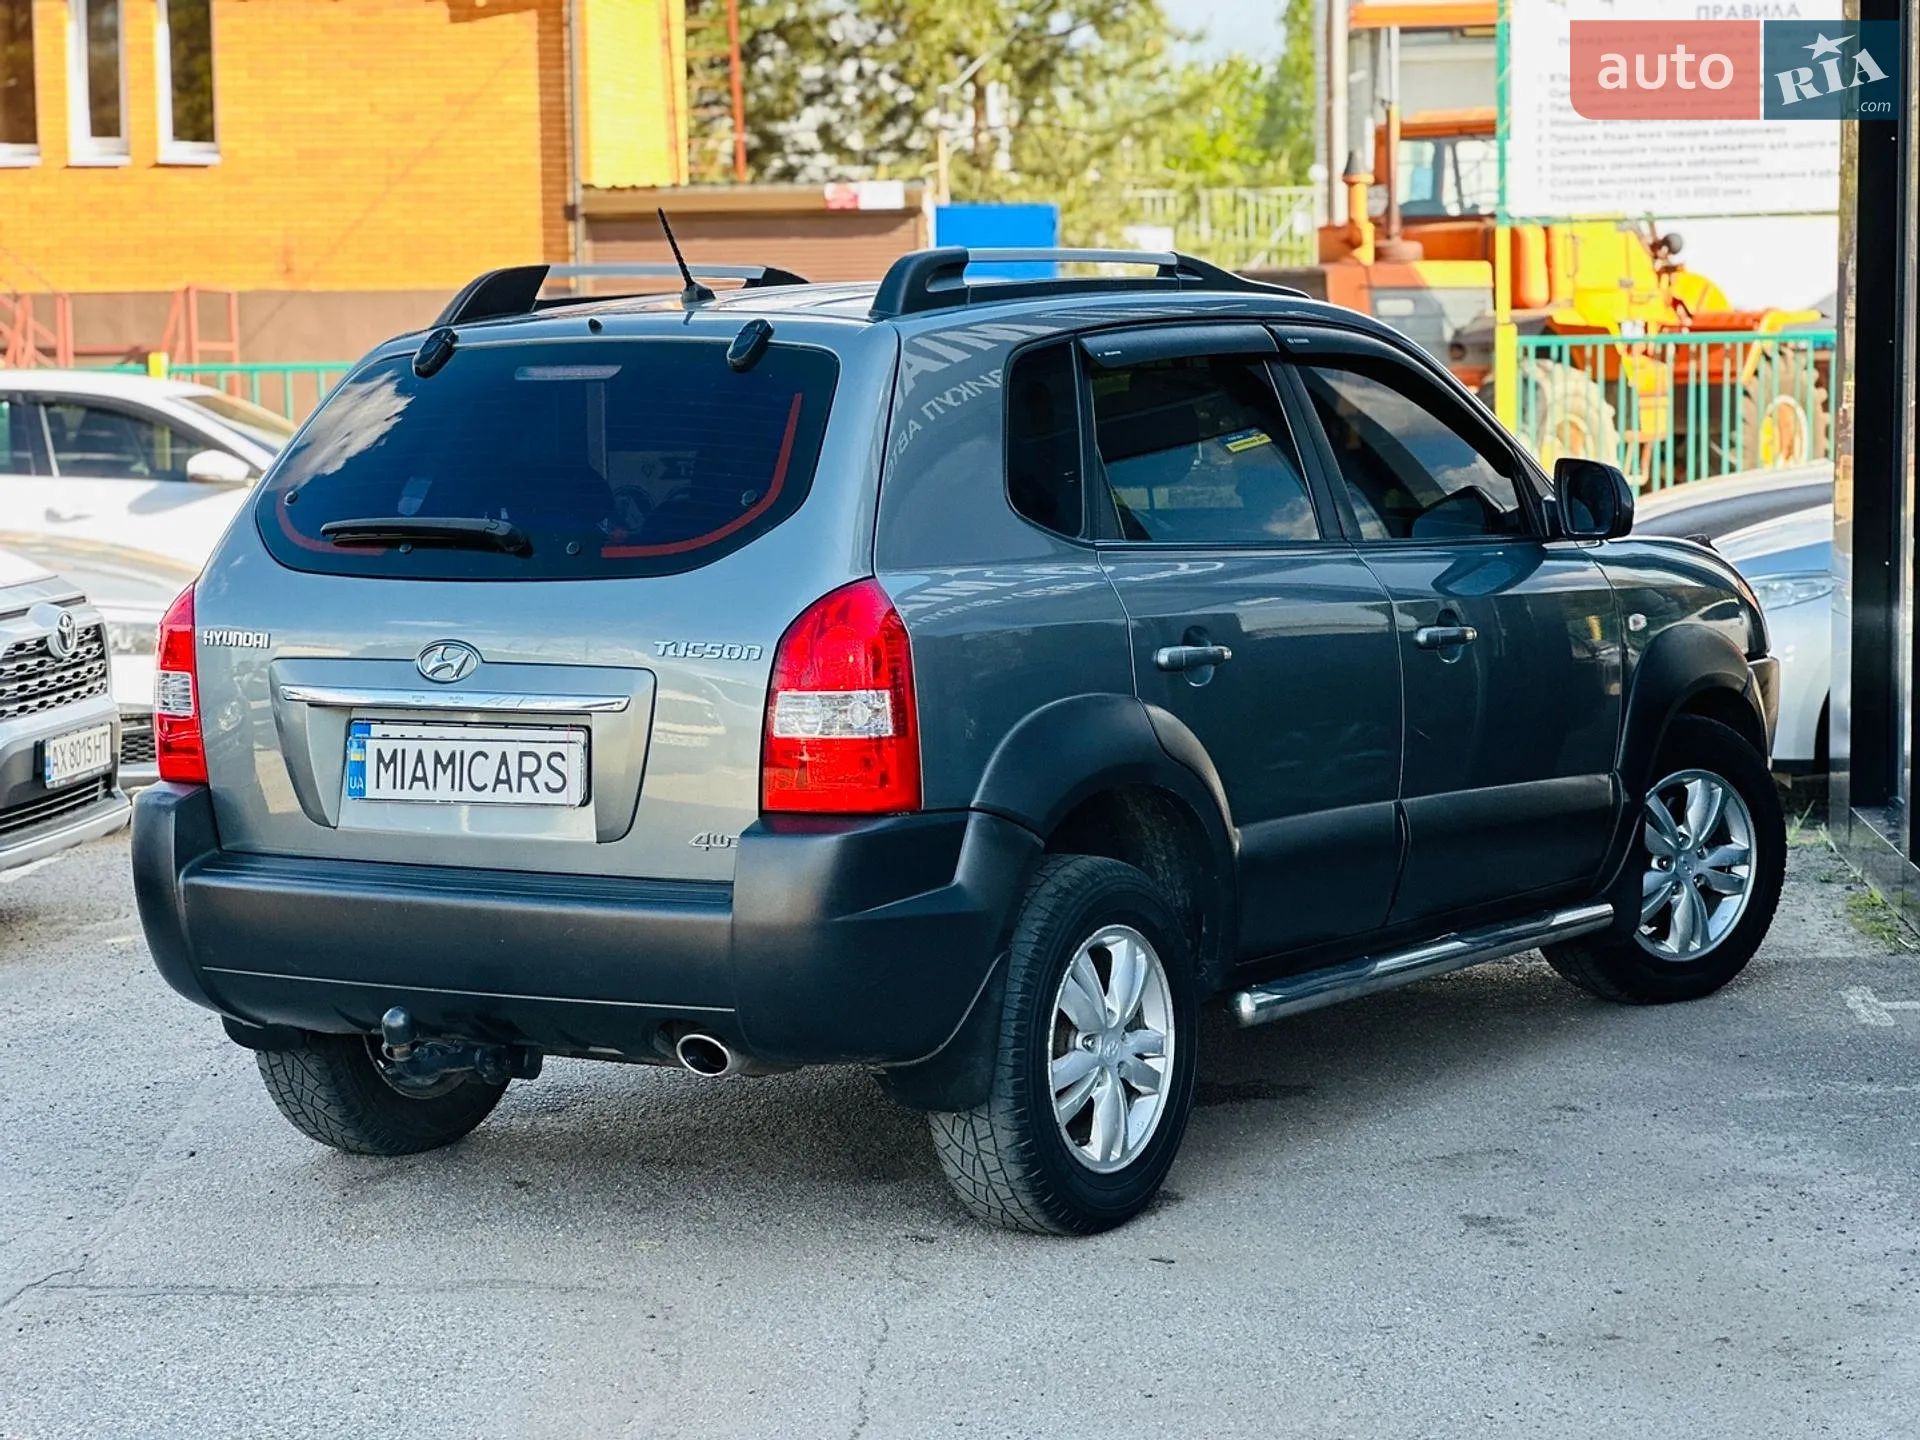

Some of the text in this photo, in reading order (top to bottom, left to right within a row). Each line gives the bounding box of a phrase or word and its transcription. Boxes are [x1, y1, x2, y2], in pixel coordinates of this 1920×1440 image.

[1696, 3, 1802, 21] ПРАВИЛА
[202, 629, 271, 649] HYUNDAI
[653, 640, 763, 661] TUCSON
[349, 747, 568, 795] UA MIAMICARS
